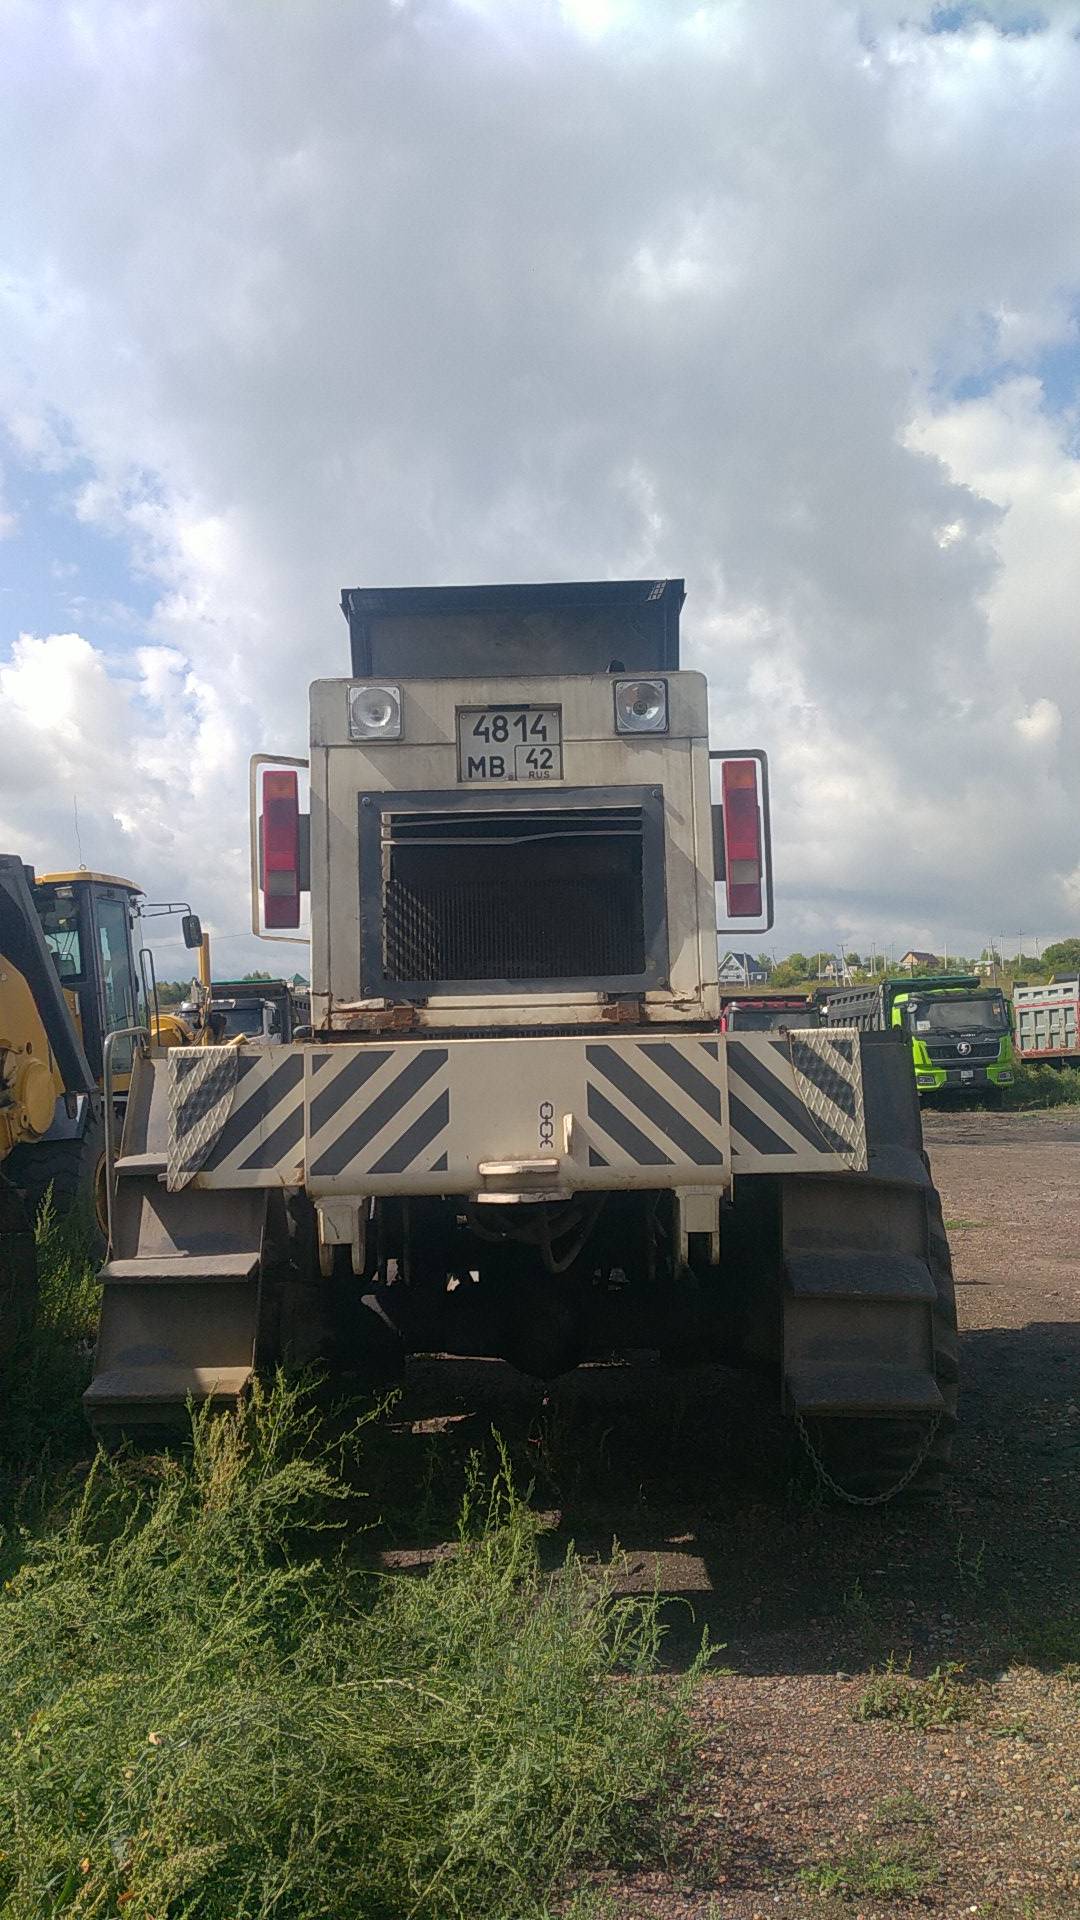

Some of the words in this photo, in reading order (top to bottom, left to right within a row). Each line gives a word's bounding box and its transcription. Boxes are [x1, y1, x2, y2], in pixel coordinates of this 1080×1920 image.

[473, 714, 547, 743] 4814
[467, 756, 505, 778] MB
[525, 748, 553, 769] 42
[528, 770, 550, 779] RUS
